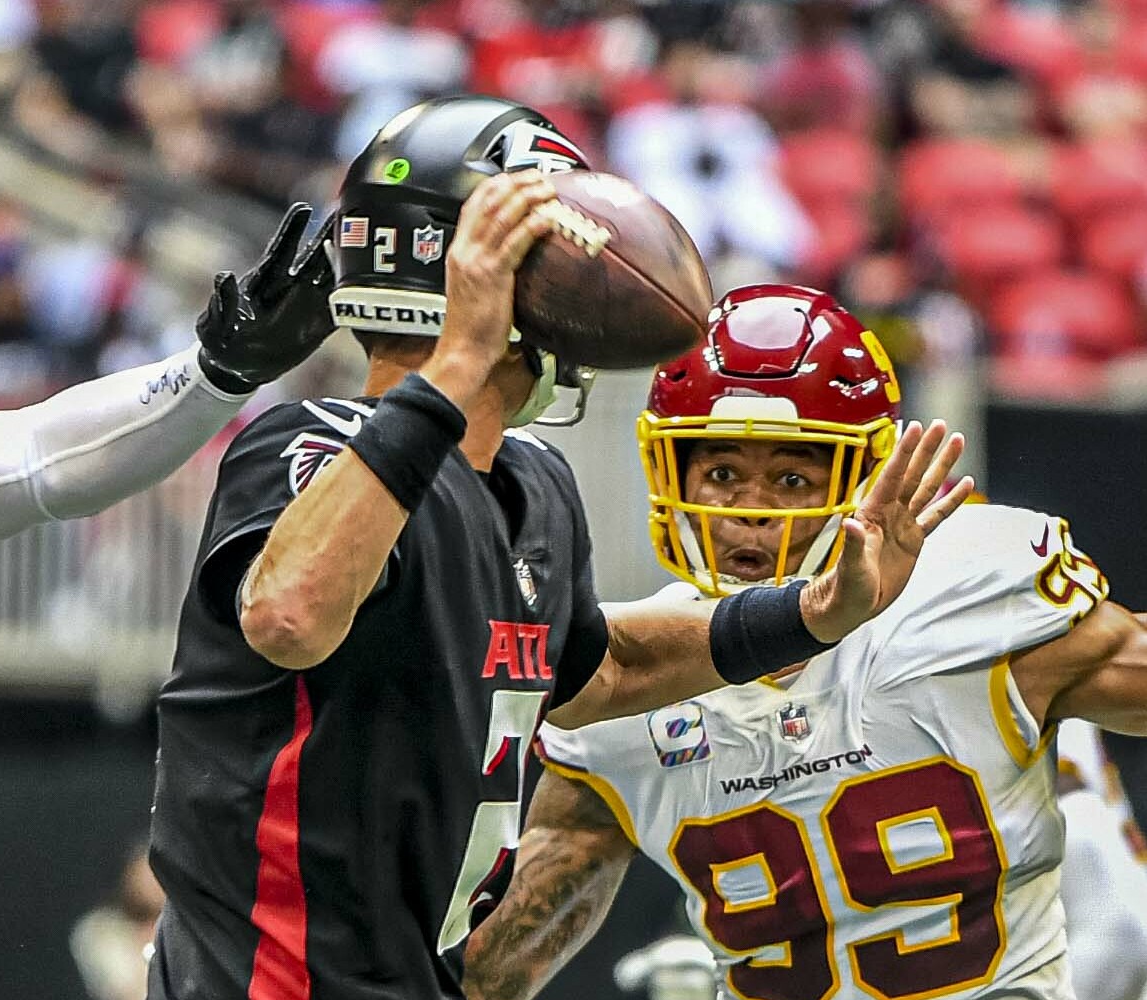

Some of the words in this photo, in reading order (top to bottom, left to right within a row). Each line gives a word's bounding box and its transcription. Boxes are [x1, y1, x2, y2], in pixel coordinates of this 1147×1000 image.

[373, 226, 397, 273] 2
[335, 303, 446, 326] FALCON
[481, 620, 554, 679] ATL
[720, 743, 873, 795] WASHINGTON
